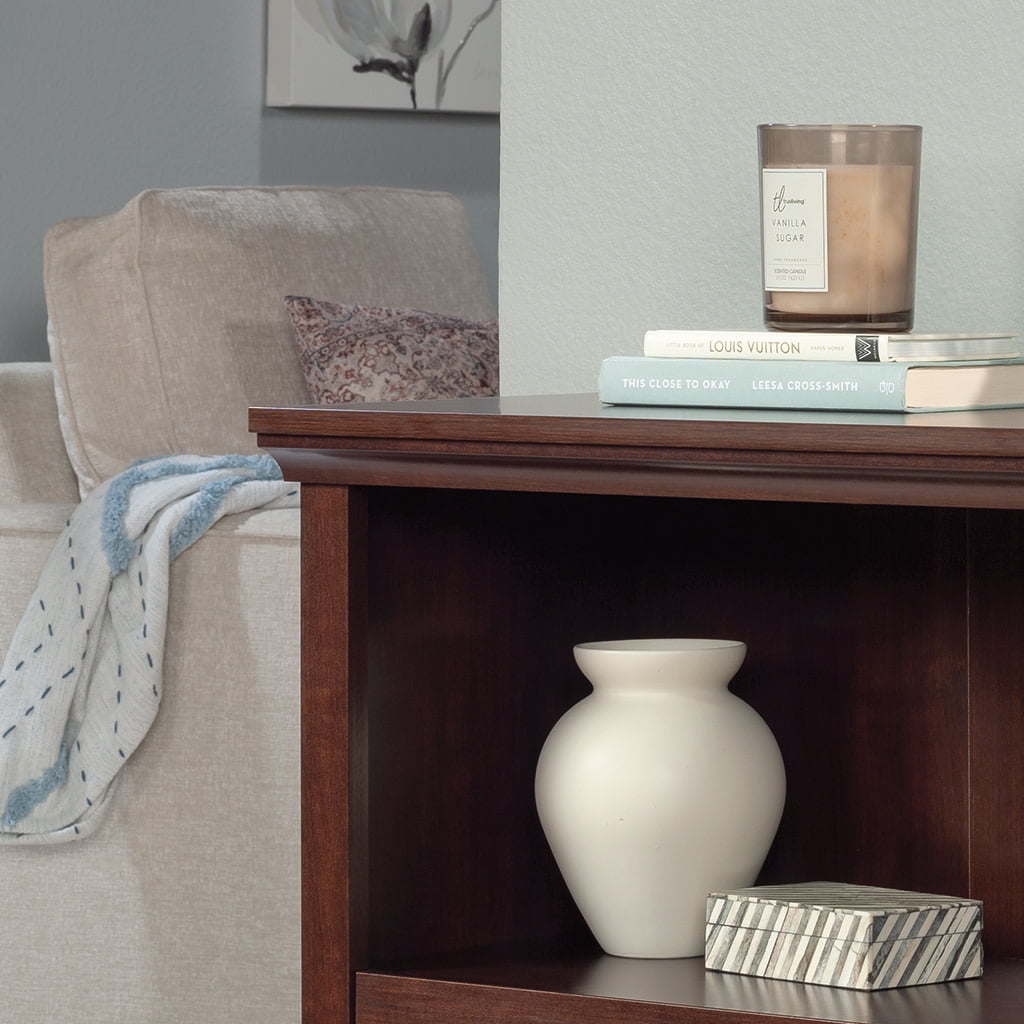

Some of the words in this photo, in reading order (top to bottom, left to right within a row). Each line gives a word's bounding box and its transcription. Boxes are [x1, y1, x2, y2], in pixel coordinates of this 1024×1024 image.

[772, 219, 806, 228] VANILLA
[776, 233, 805, 242] SUGAR
[709, 340, 743, 353] LOUIS
[747, 340, 801, 354] VUITTON
[622, 378, 646, 388] THIS
[648, 378, 682, 389] CLOSE
[685, 379, 699, 389] TO
[702, 379, 731, 390] OKAY
[752, 380, 784, 390] LEESA
[787, 380, 858, 391] CROSS-SMITH
